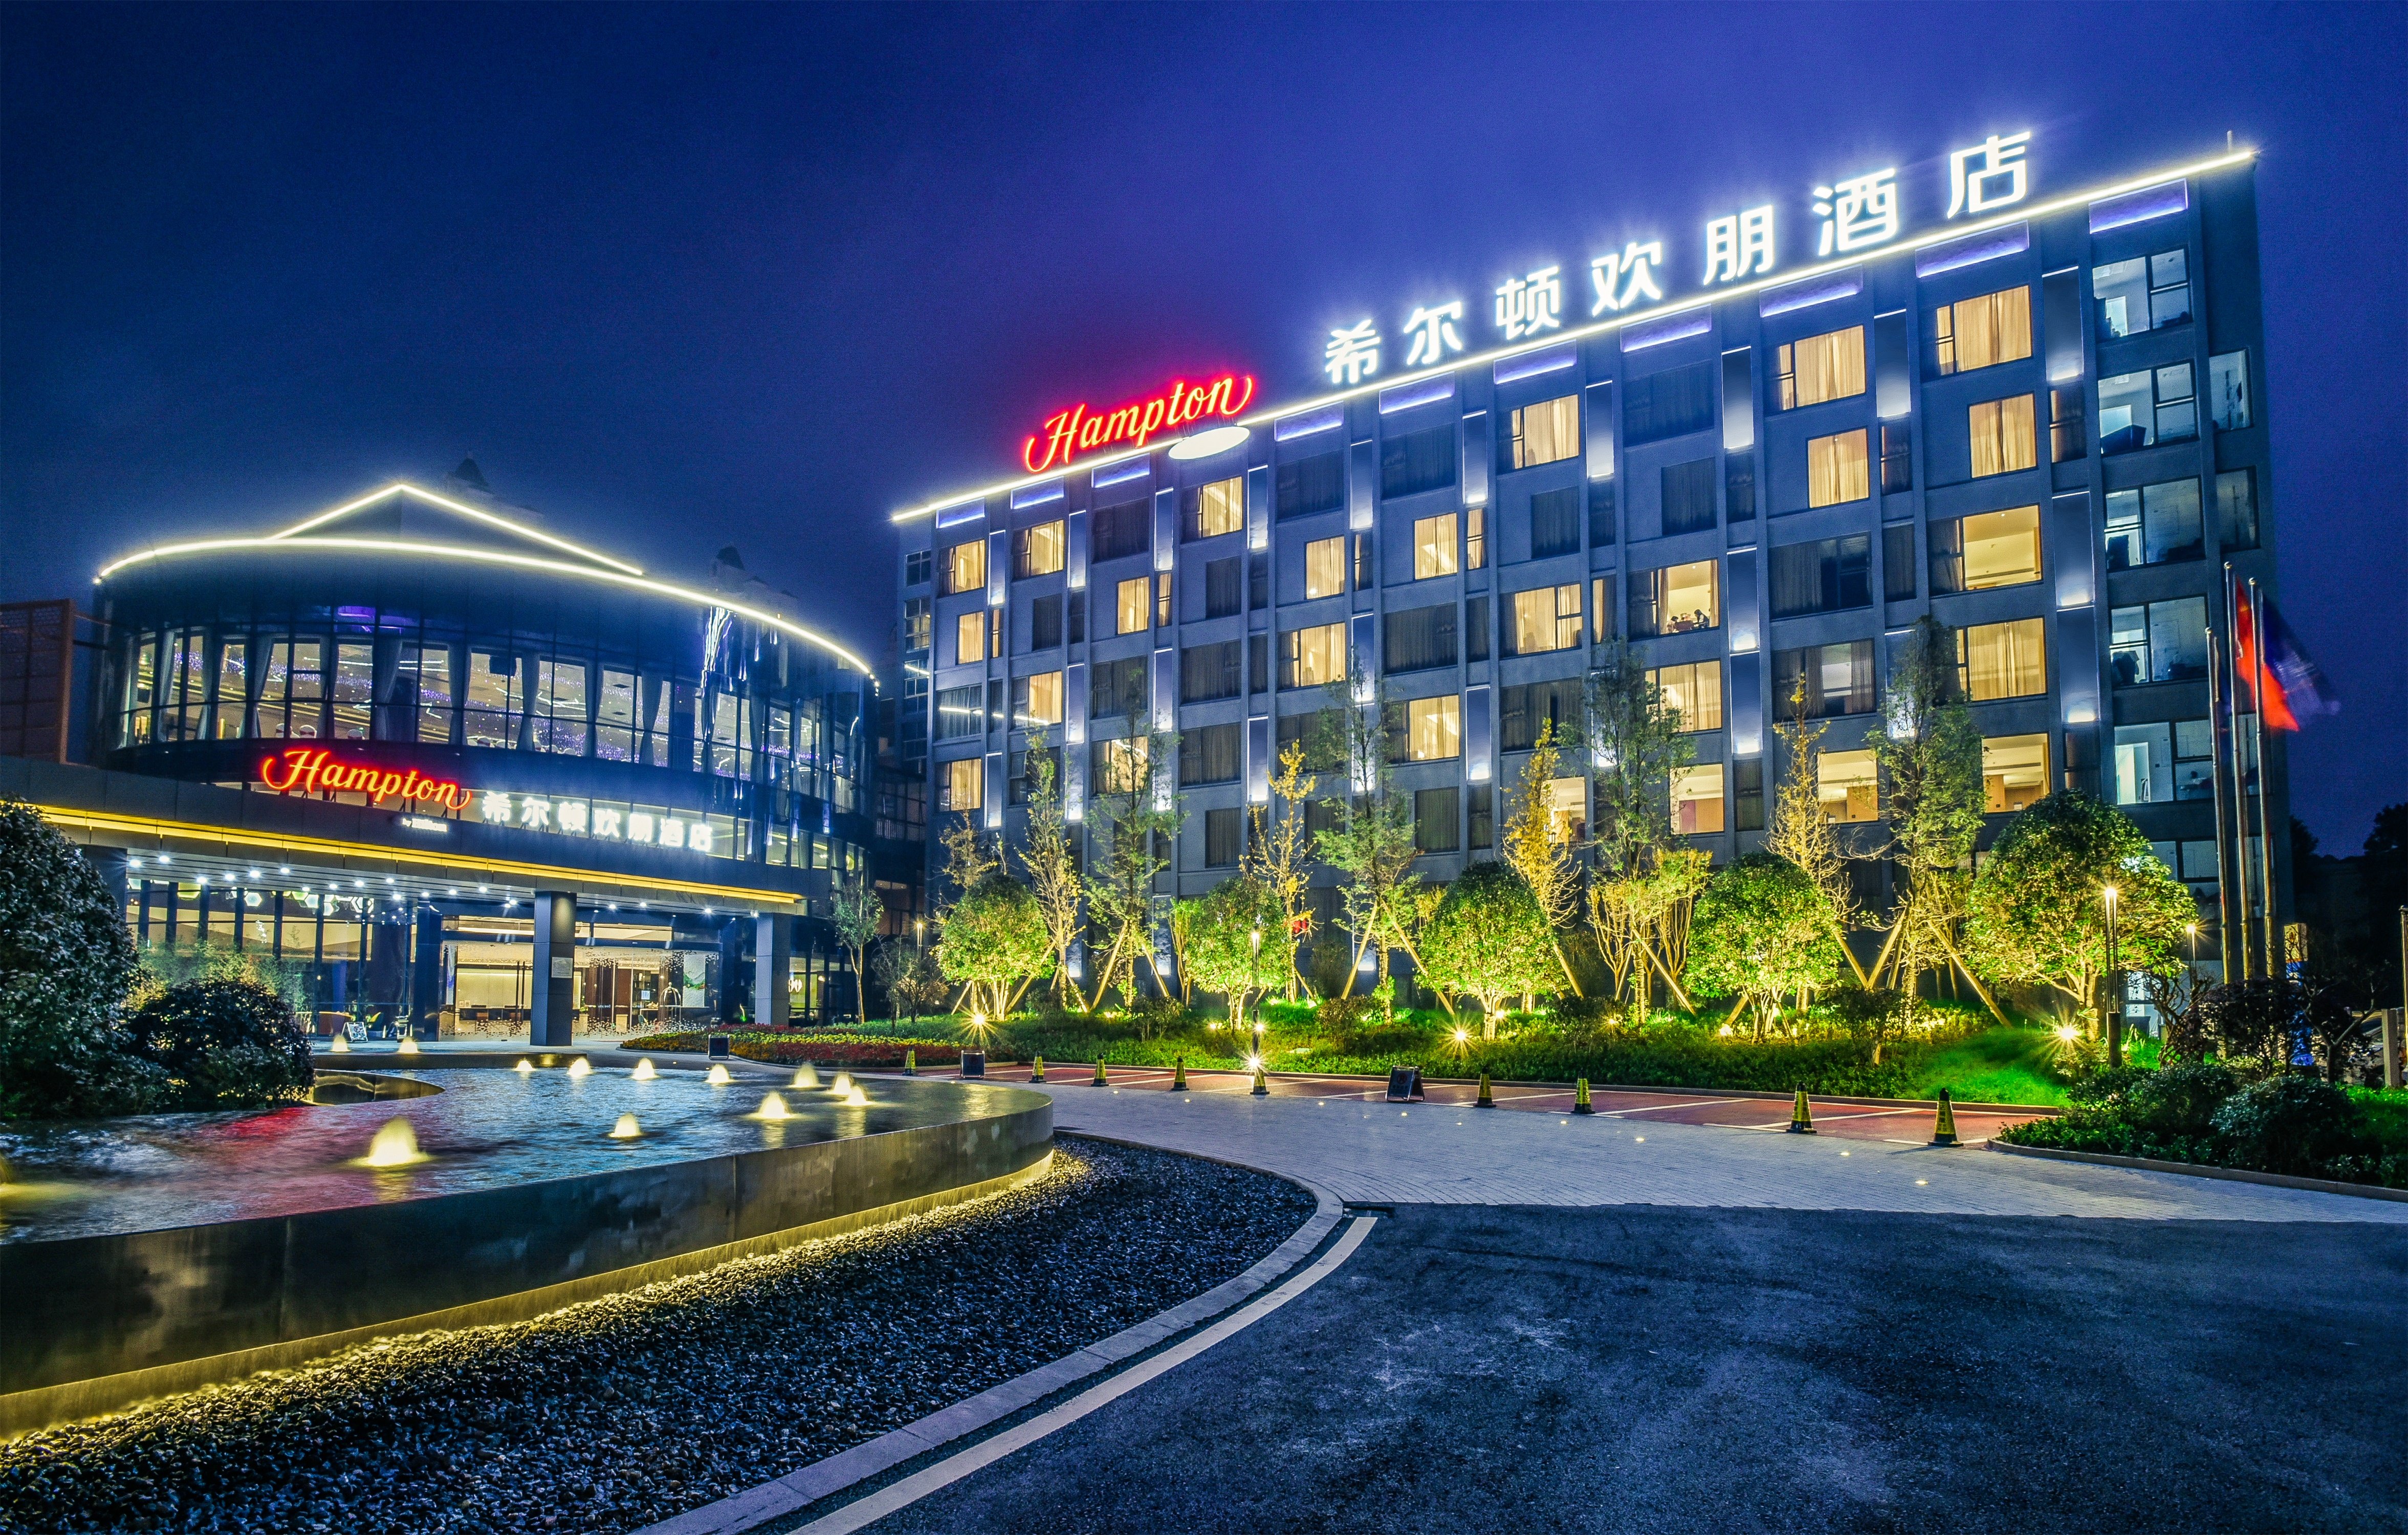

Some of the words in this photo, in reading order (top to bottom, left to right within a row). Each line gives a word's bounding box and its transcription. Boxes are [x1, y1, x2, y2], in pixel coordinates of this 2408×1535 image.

[1323, 130, 2032, 384] 希尔顿欢朋酒店
[1022, 374, 1254, 473] Hampton
[262, 749, 472, 810] Hampton
[482, 791, 714, 852] 希尔顿欢朋酒店
